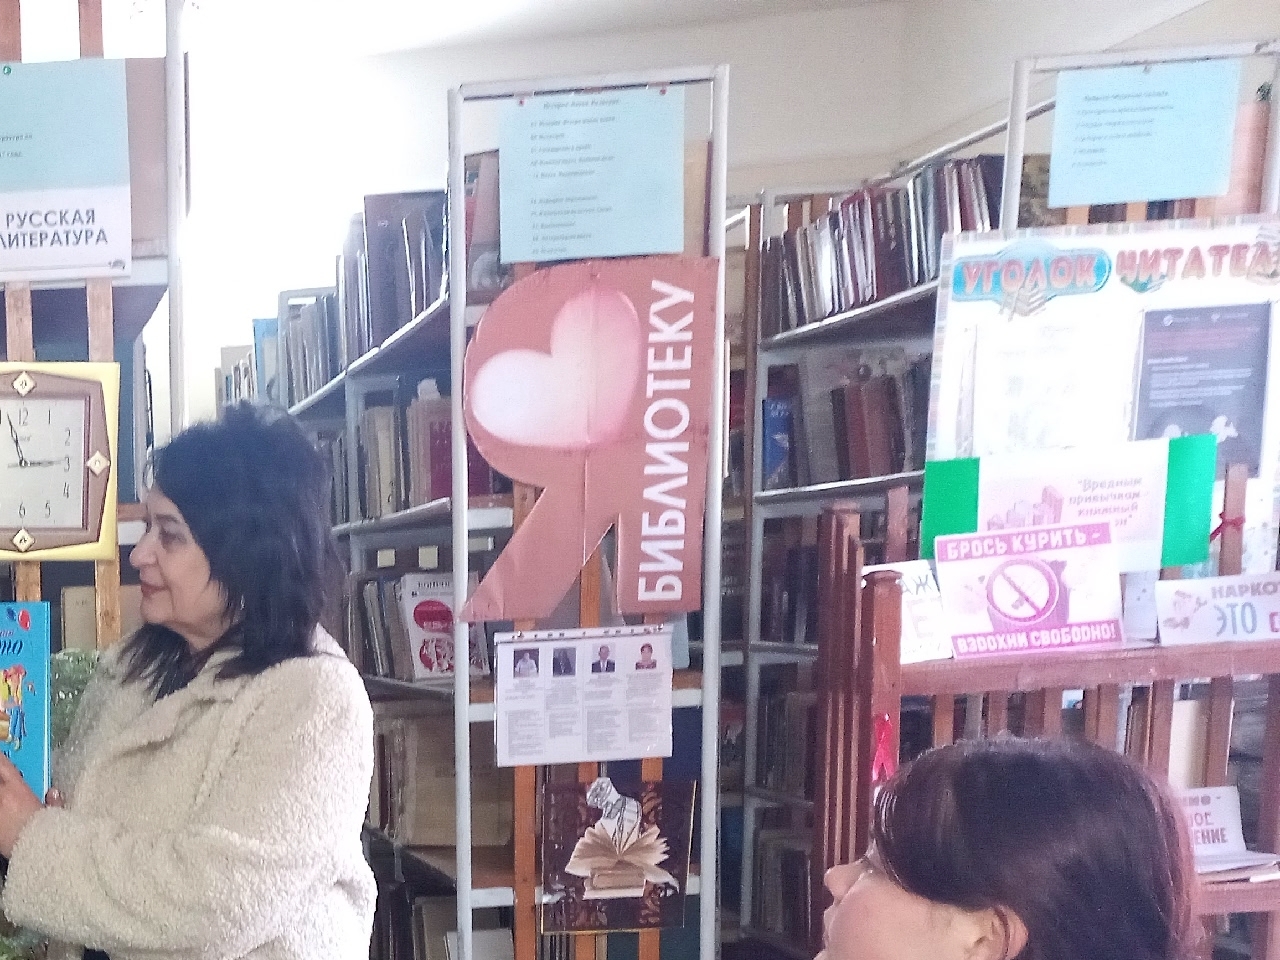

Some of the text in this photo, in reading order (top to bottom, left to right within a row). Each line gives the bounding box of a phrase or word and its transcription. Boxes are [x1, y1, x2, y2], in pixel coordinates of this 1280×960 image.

[6, 208, 96, 229] РУССКАЯ
[1116, 240, 1280, 283] ЧИТАТЕЛ
[962, 254, 1097, 294] УГОЛОК
[19, 408, 30, 427] 12
[65, 427, 72, 445] 2
[637, 278, 696, 604] БИБЛИОТЕКУ
[63, 481, 71, 499] 4
[18, 501, 27, 519] 6
[44, 500, 52, 518] 5
[946, 535, 1008, 560] БРОСЬ
[1012, 528, 1087, 552] КУРИТЬ
[1211, 581, 1280, 599] НАРКО
[1212, 601, 1258, 638] ЭТО
[956, 623, 1117, 653] ВЗДОХНИ СВОБОДНО!
